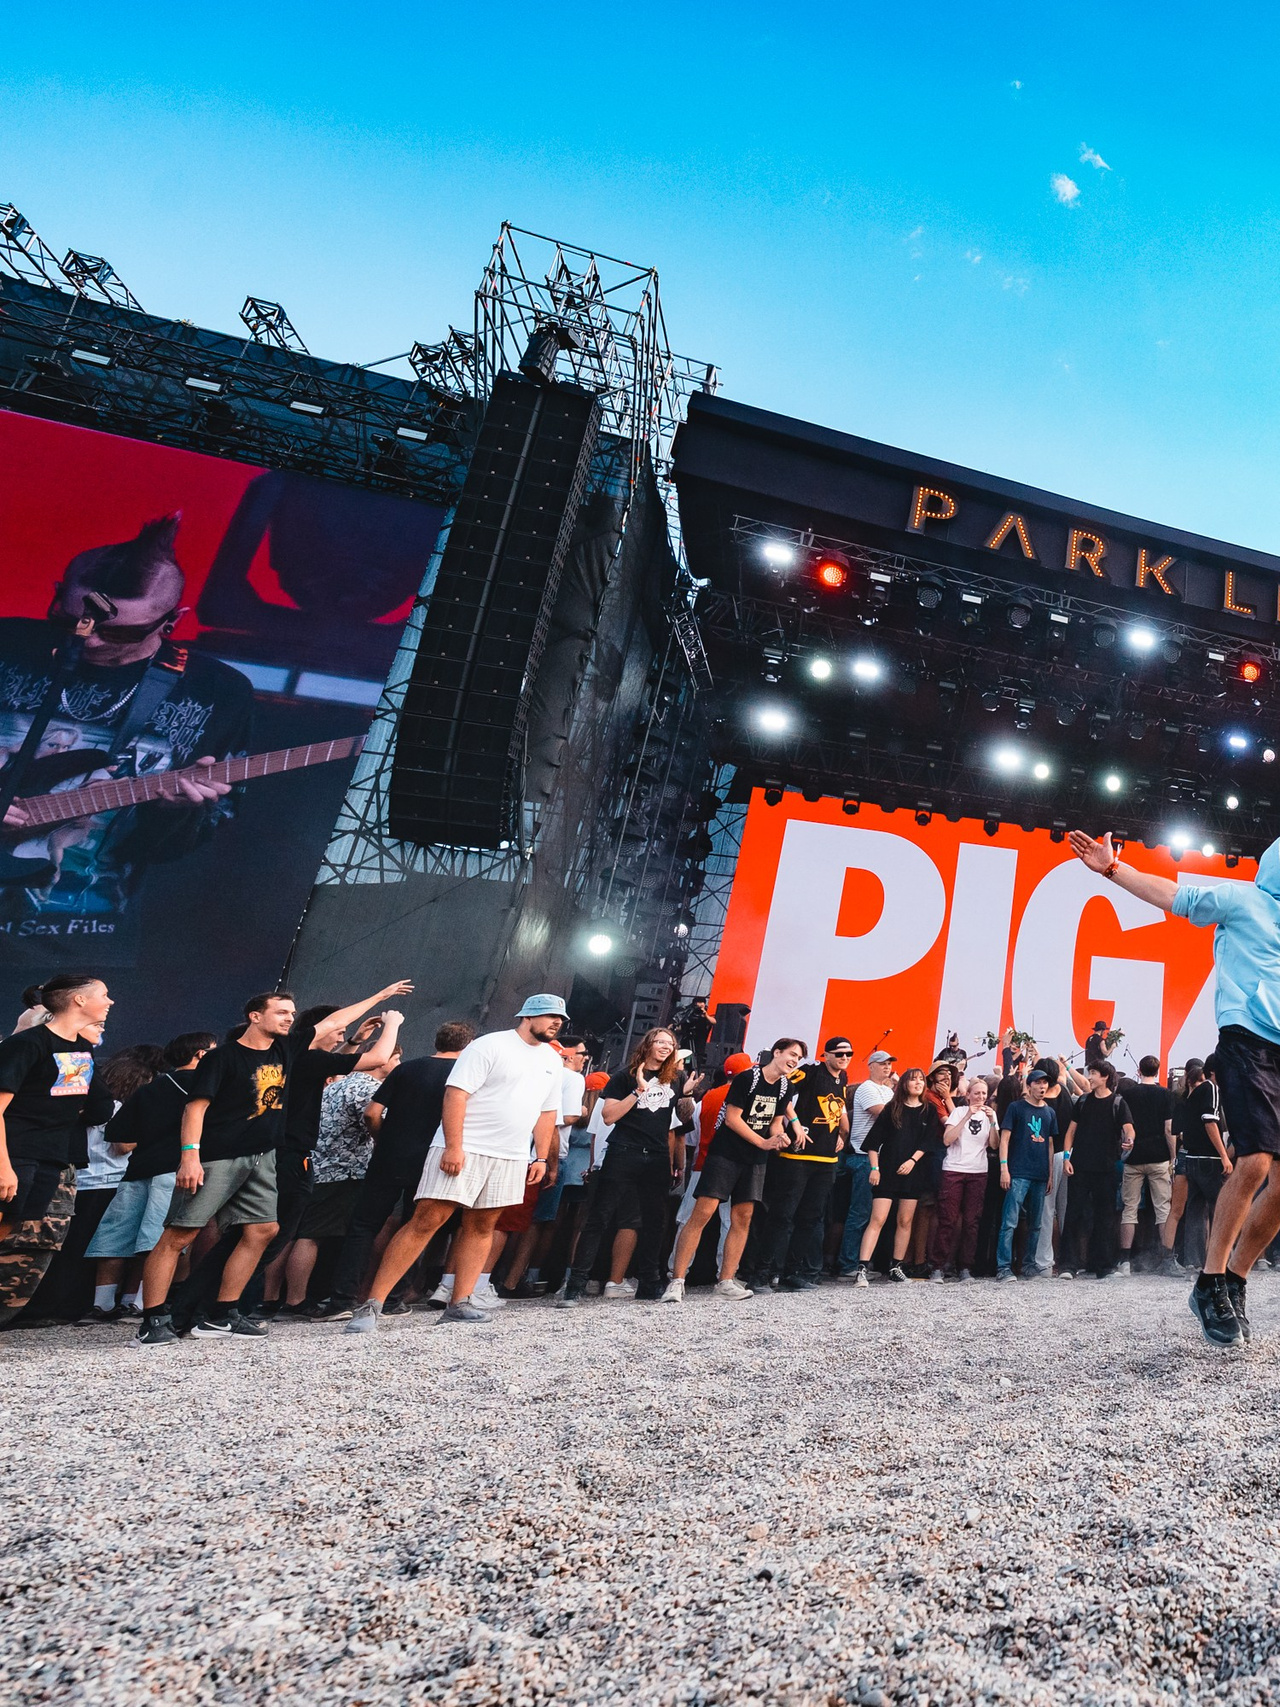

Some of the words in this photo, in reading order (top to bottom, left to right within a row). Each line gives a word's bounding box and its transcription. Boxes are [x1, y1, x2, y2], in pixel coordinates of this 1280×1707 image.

[909, 484, 1176, 597] PARK
[18, 919, 60, 936] Sex
[66, 919, 115, 934] Files
